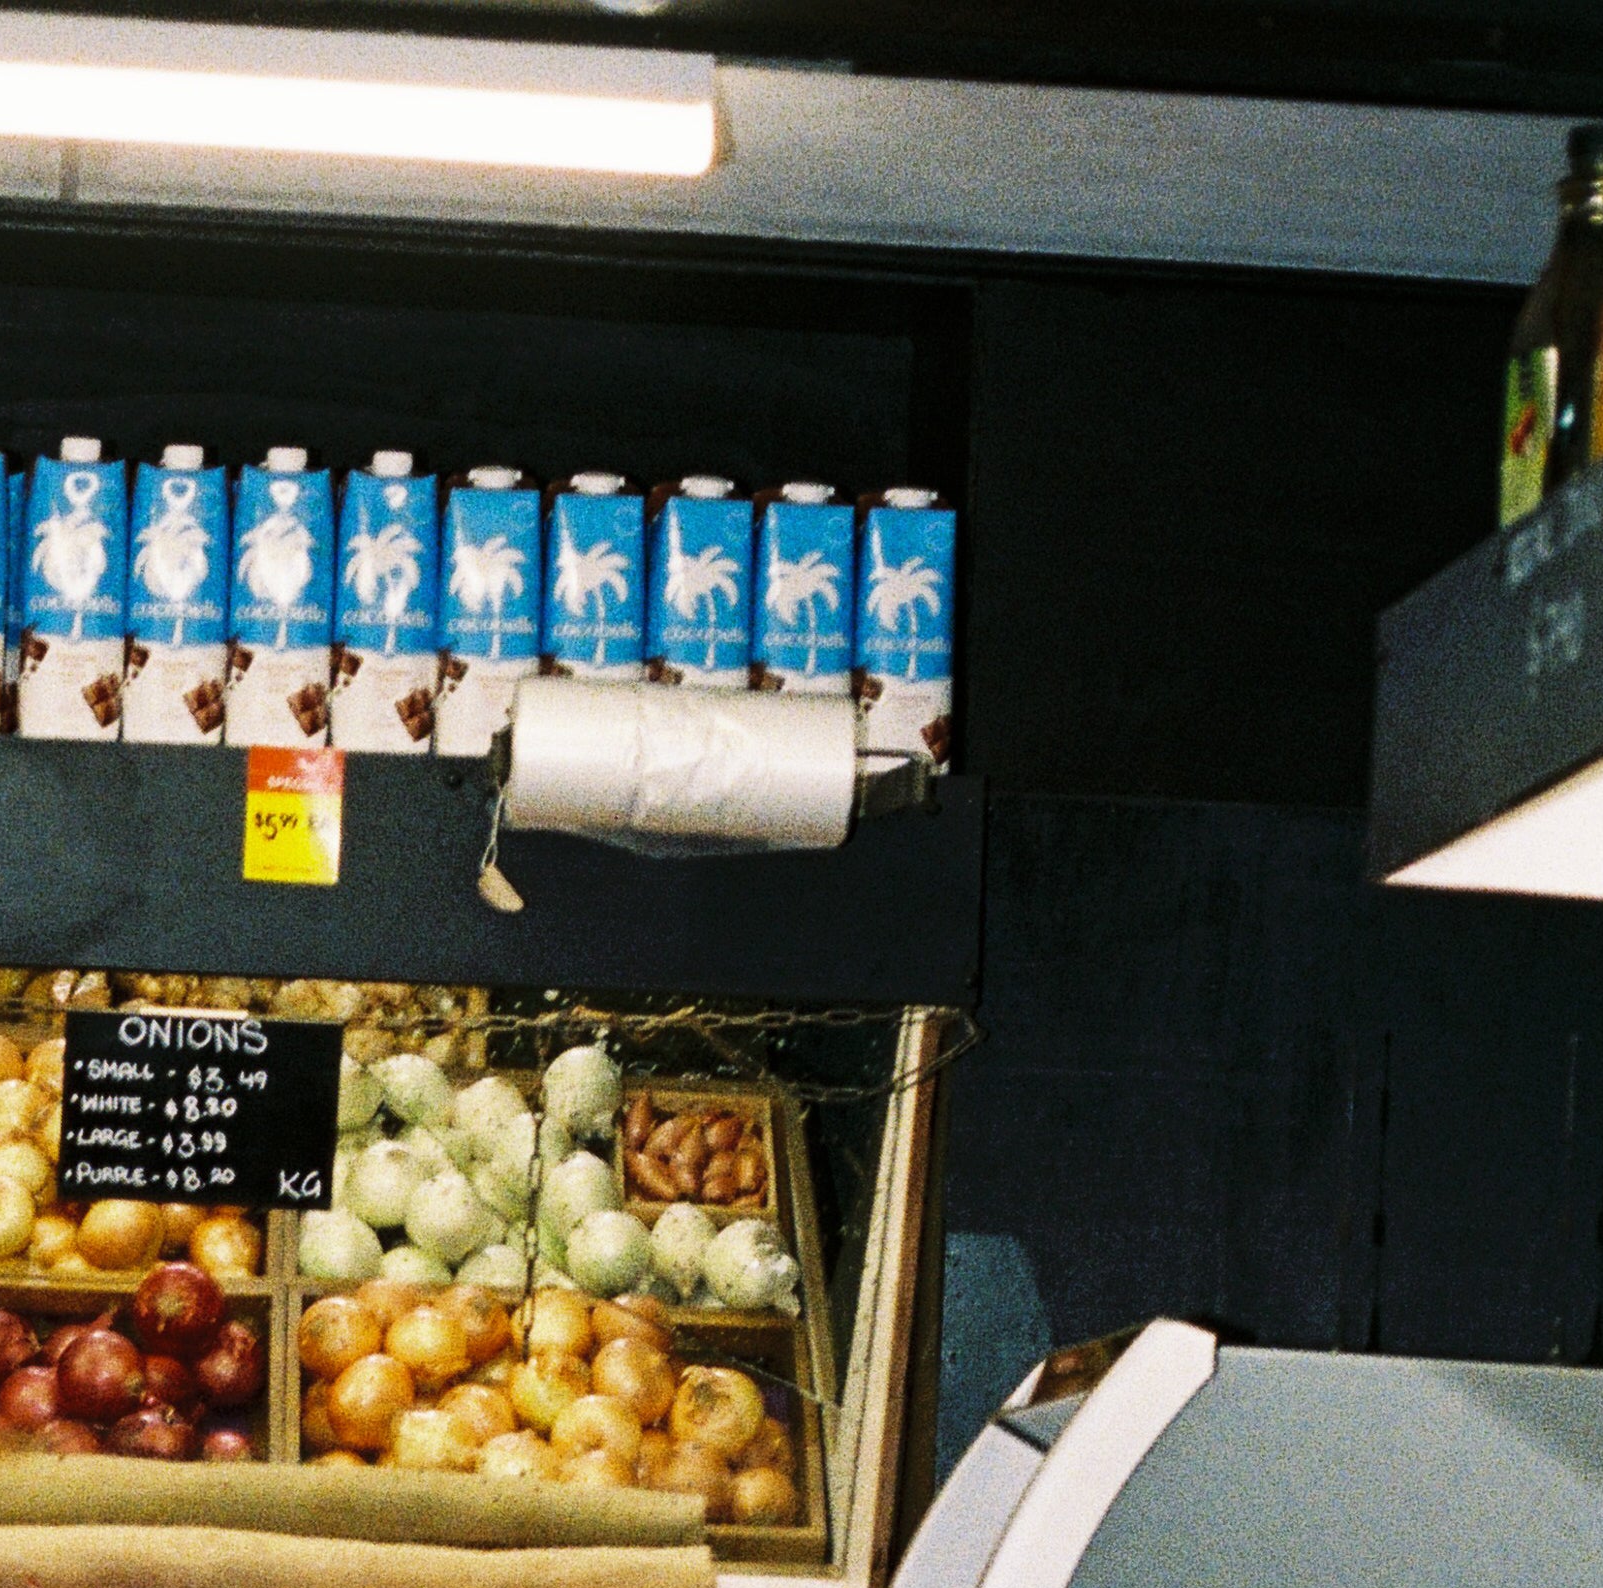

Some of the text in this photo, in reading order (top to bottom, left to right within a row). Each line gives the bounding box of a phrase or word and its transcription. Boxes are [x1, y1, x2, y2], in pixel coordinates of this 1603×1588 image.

[117, 1015, 269, 1056] ONIONS
[87, 1057, 155, 1083] SMALL
[80, 1094, 143, 1115] WHITE
[76, 1127, 143, 1150] LARGE
[75, 1160, 148, 1189] PURPLE
[277, 1169, 322, 1200] KG
